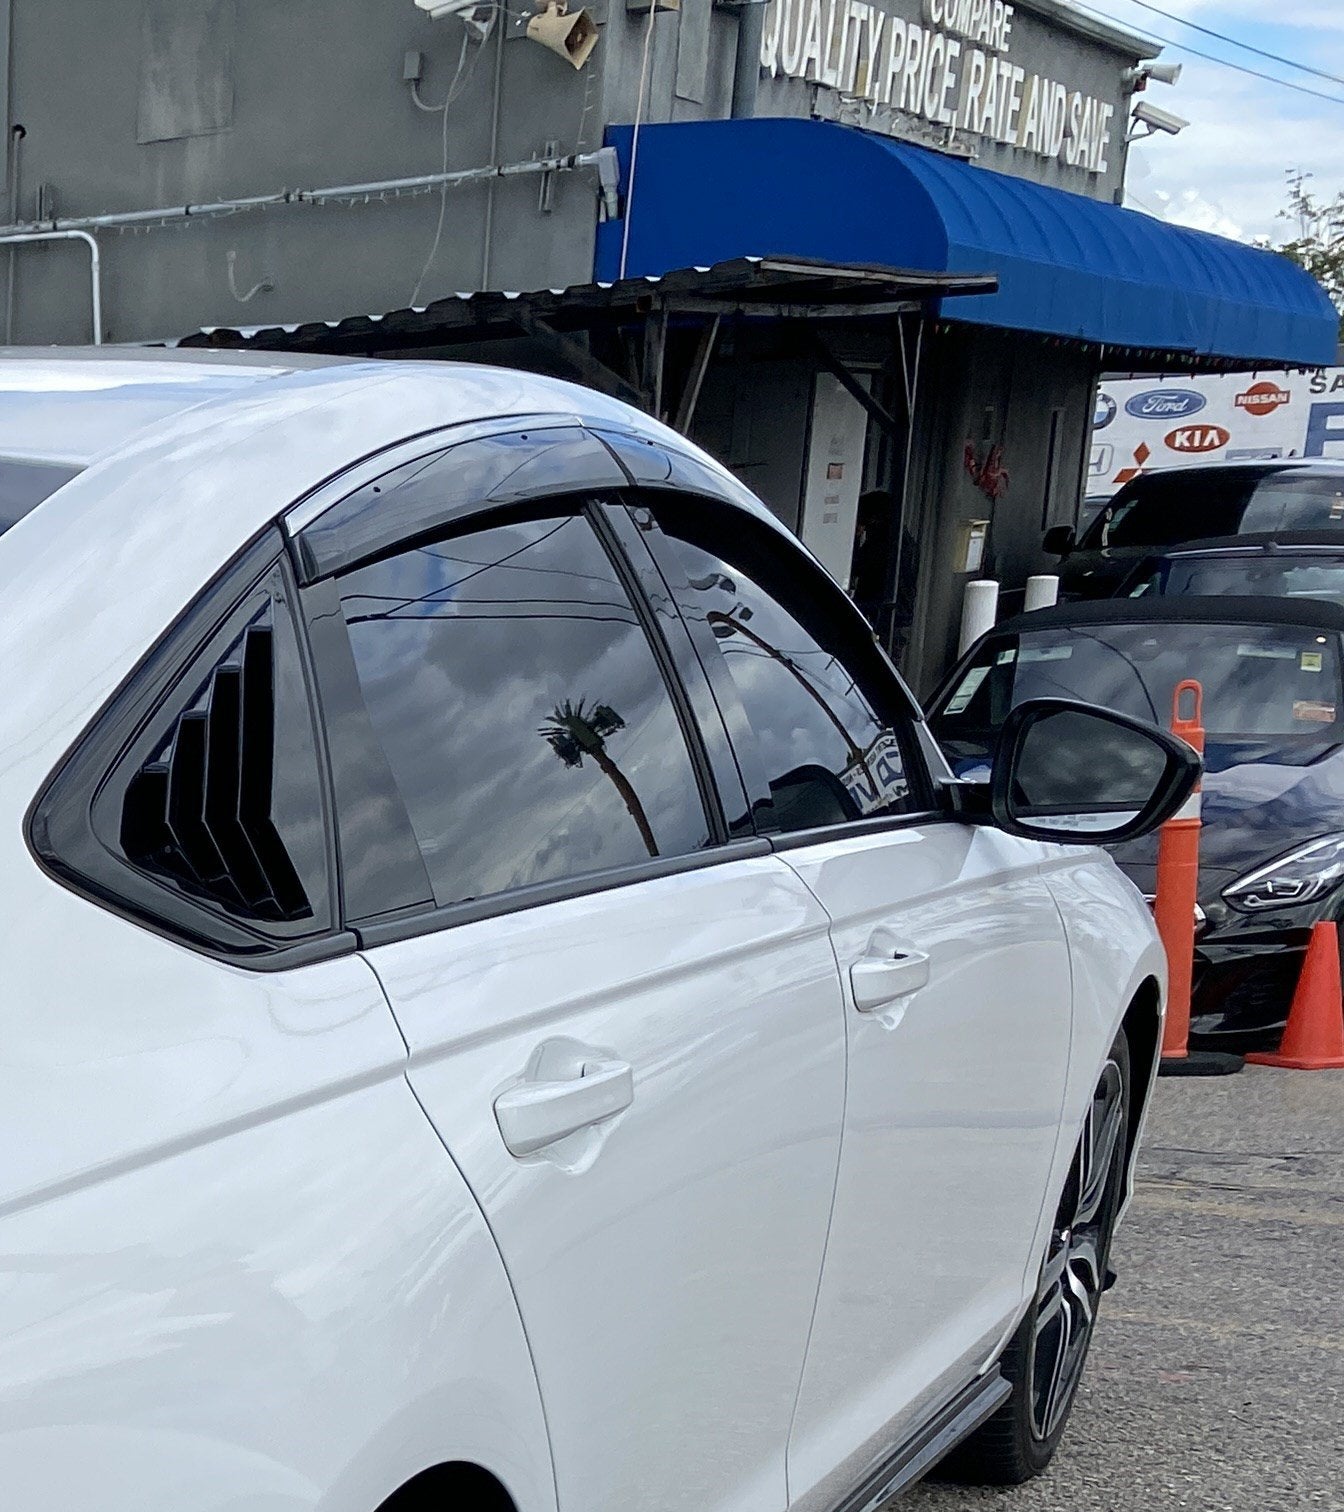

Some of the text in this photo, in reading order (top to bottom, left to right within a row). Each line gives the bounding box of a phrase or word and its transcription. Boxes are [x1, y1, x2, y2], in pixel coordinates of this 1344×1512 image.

[930, 0, 1014, 52] COMPARE
[964, 50, 1025, 144] RATE
[1022, 75, 1067, 157] AND
[1067, 91, 1113, 173] SAVE
[1142, 394, 1189, 413] Ford
[1238, 392, 1289, 406] NISSAN
[1175, 431, 1221, 448] KIA
